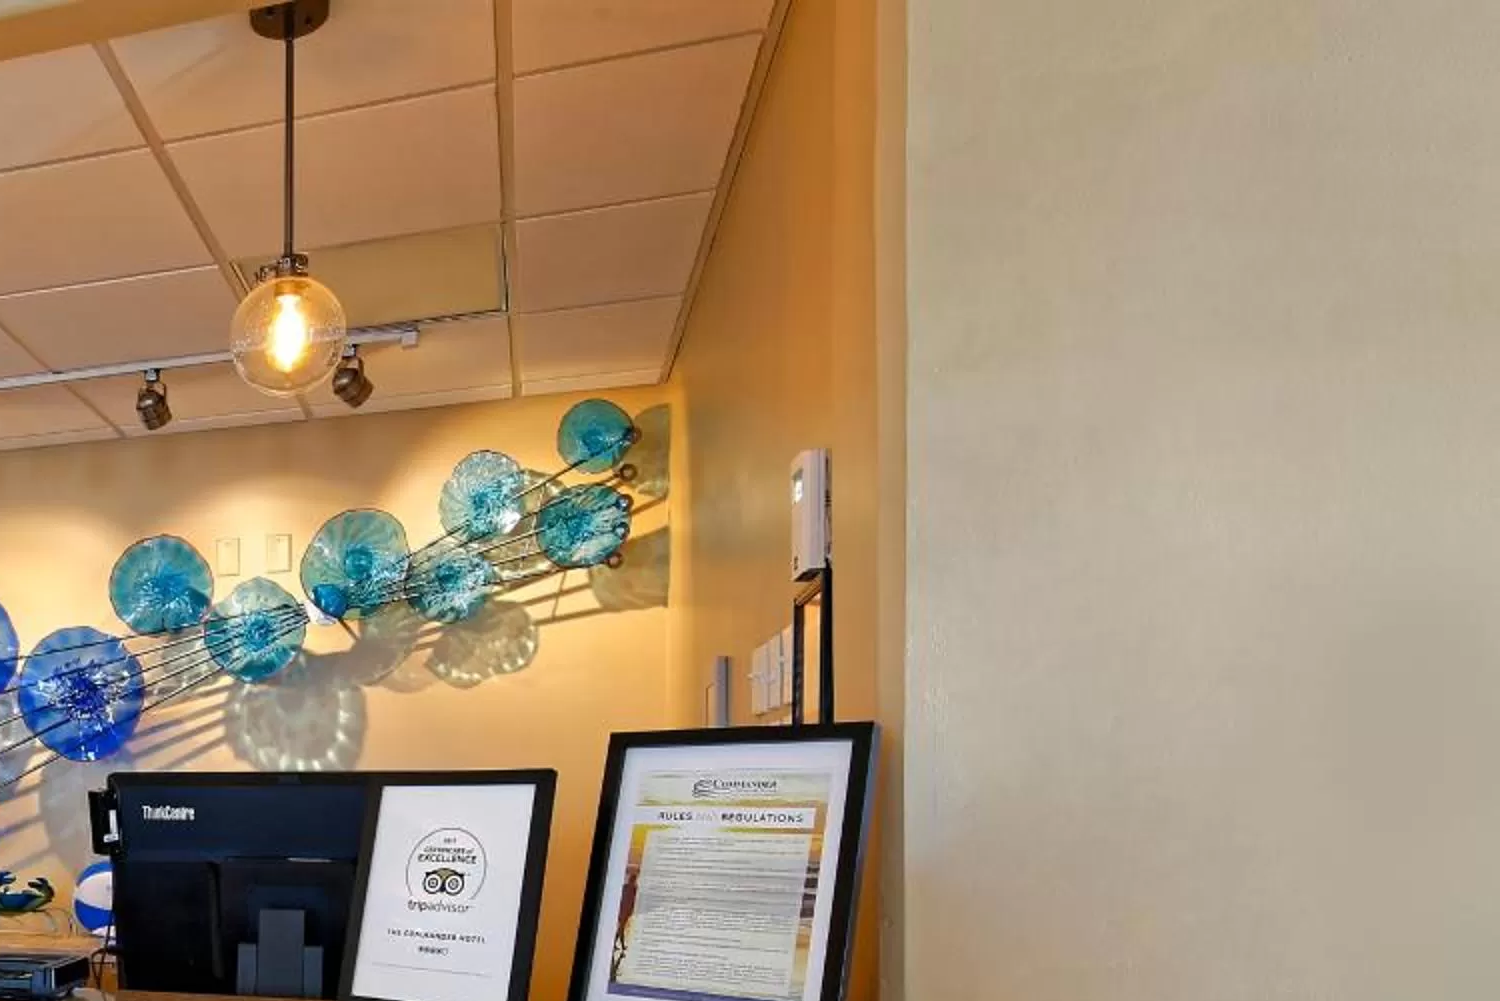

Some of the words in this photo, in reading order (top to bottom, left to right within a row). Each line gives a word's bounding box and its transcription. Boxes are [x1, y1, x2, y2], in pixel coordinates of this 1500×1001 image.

[657, 811, 693, 821] RULES
[721, 813, 804, 823] REGULATIONS
[418, 853, 477, 864] EXCELLENCE
[407, 900, 470, 913] tripadvisor
